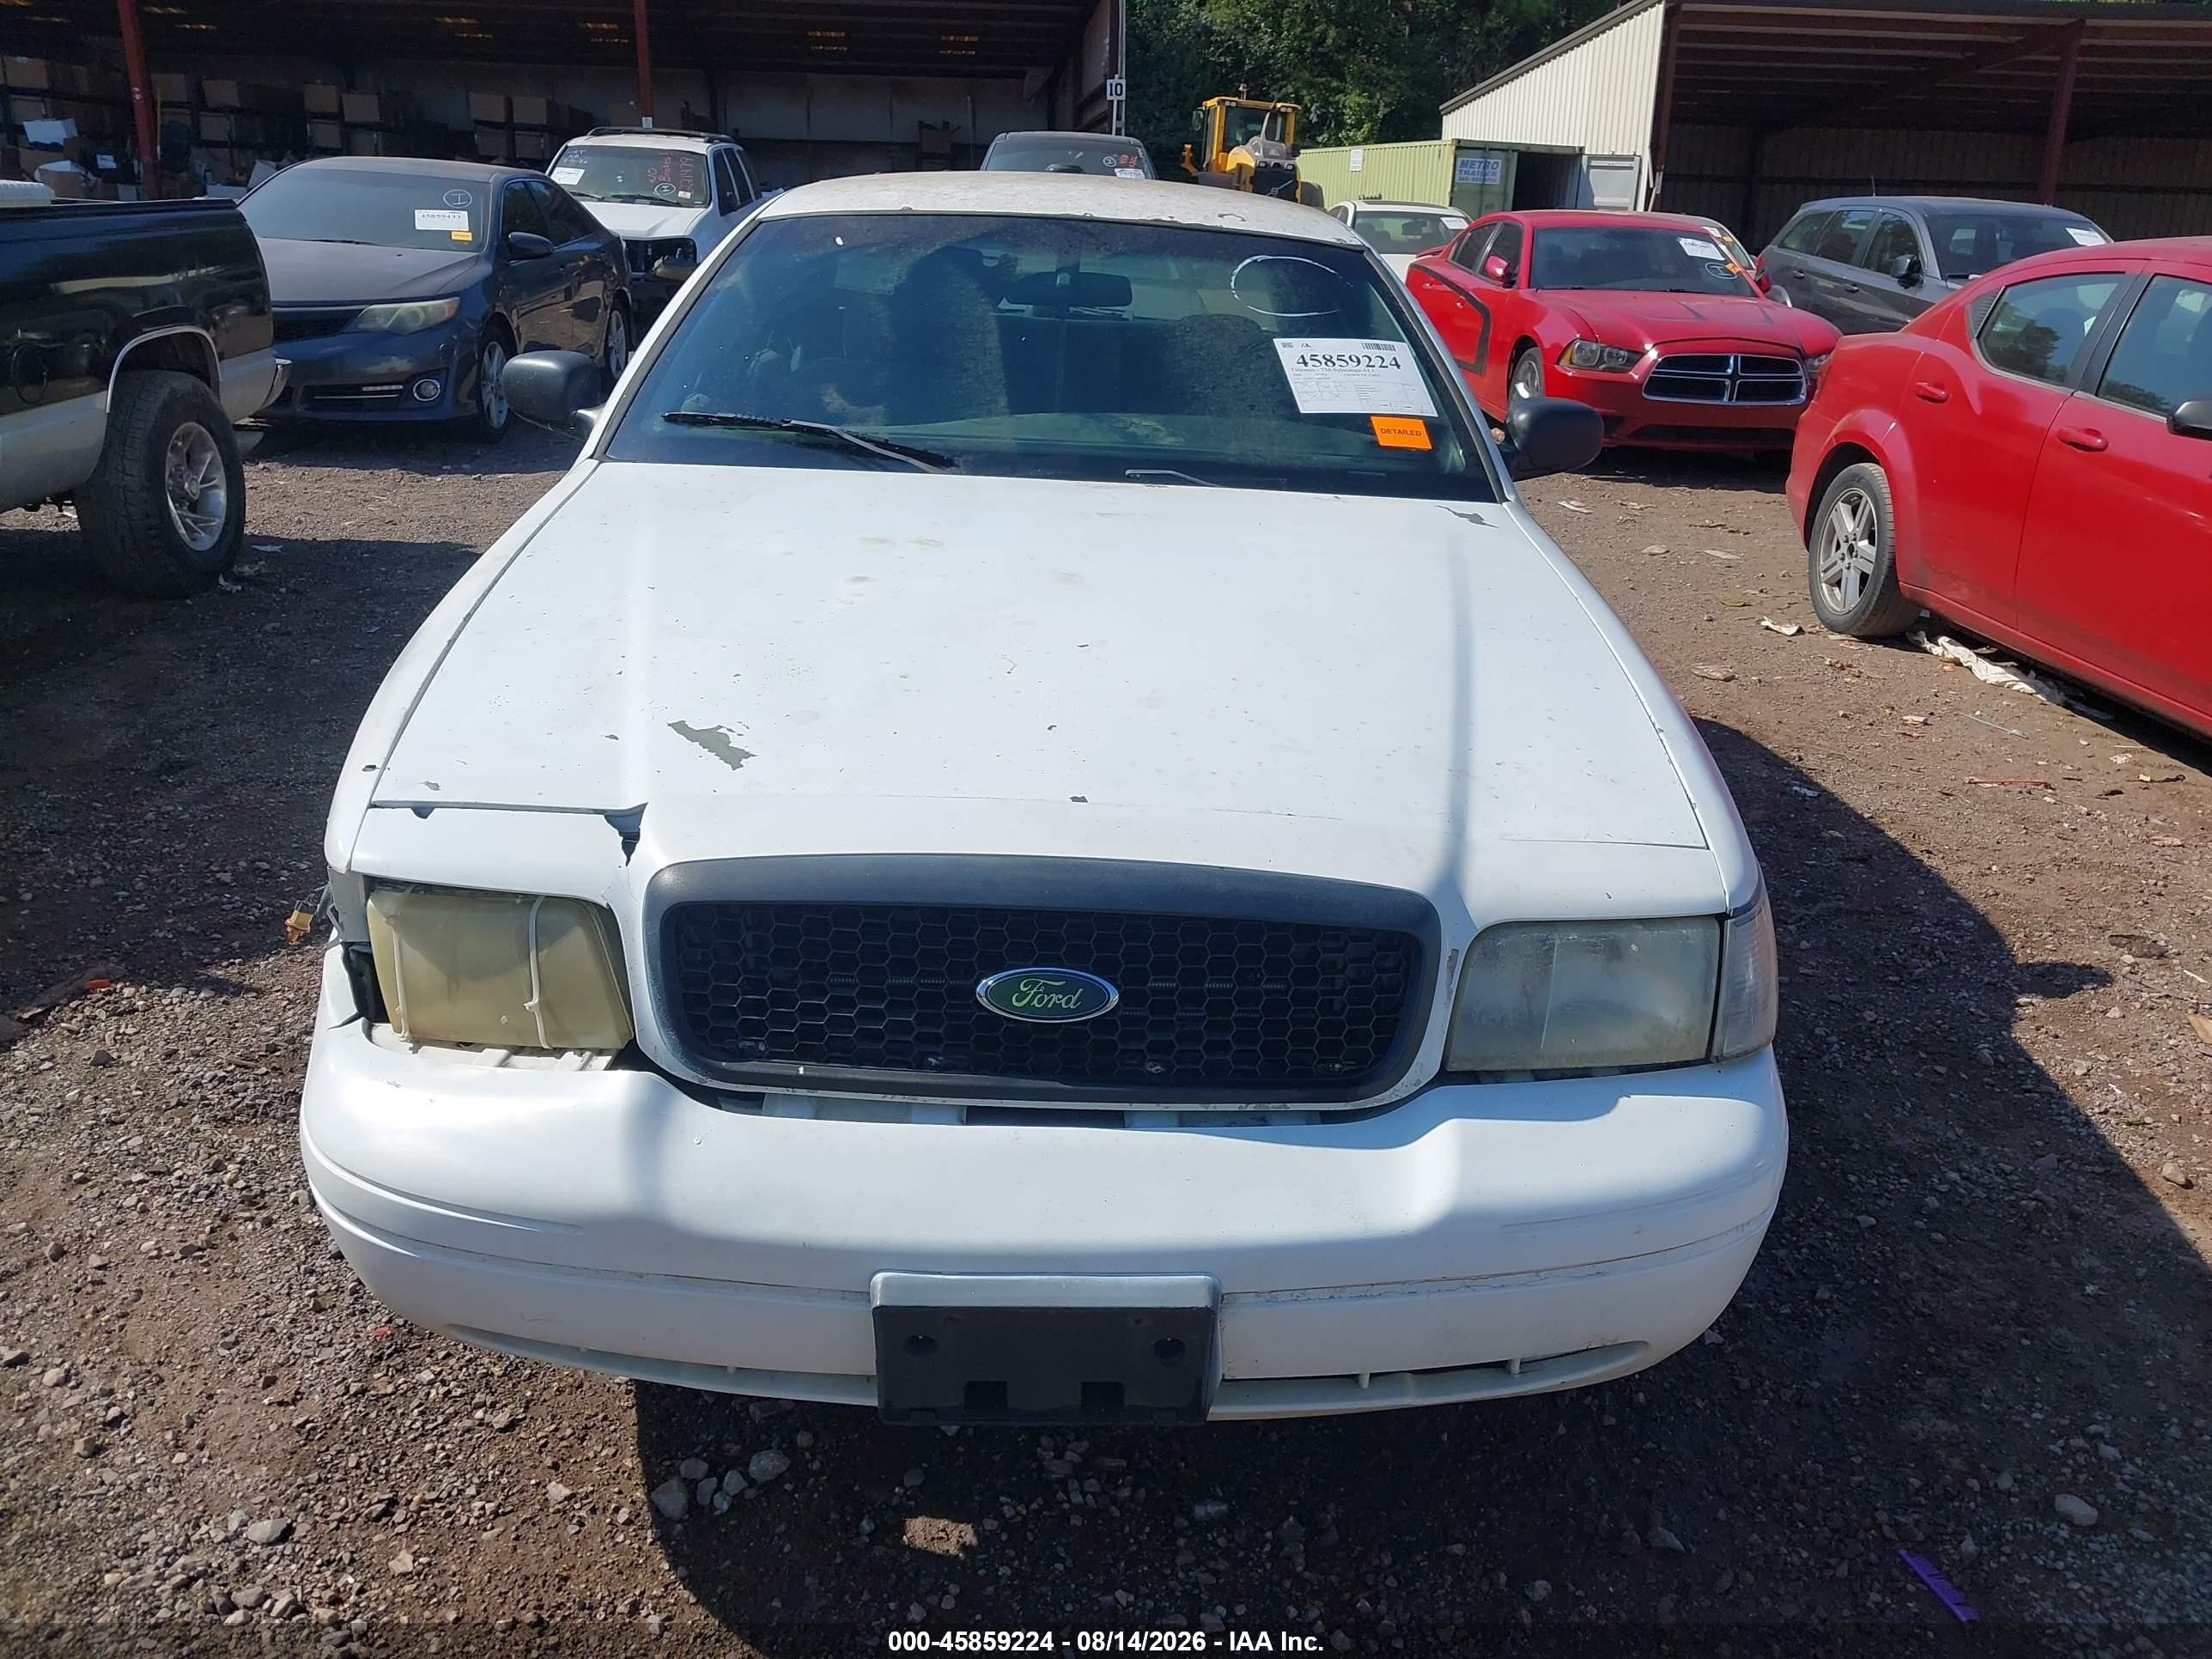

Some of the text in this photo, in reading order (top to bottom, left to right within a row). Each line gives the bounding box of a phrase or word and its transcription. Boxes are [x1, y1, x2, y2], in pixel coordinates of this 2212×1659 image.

[1109, 82, 1122, 97] 10
[1459, 160, 1499, 170] METRO
[1296, 353, 1401, 369] 45859224
[1380, 428, 1422, 437] DETAILED
[1012, 978, 1084, 1009] Ford
